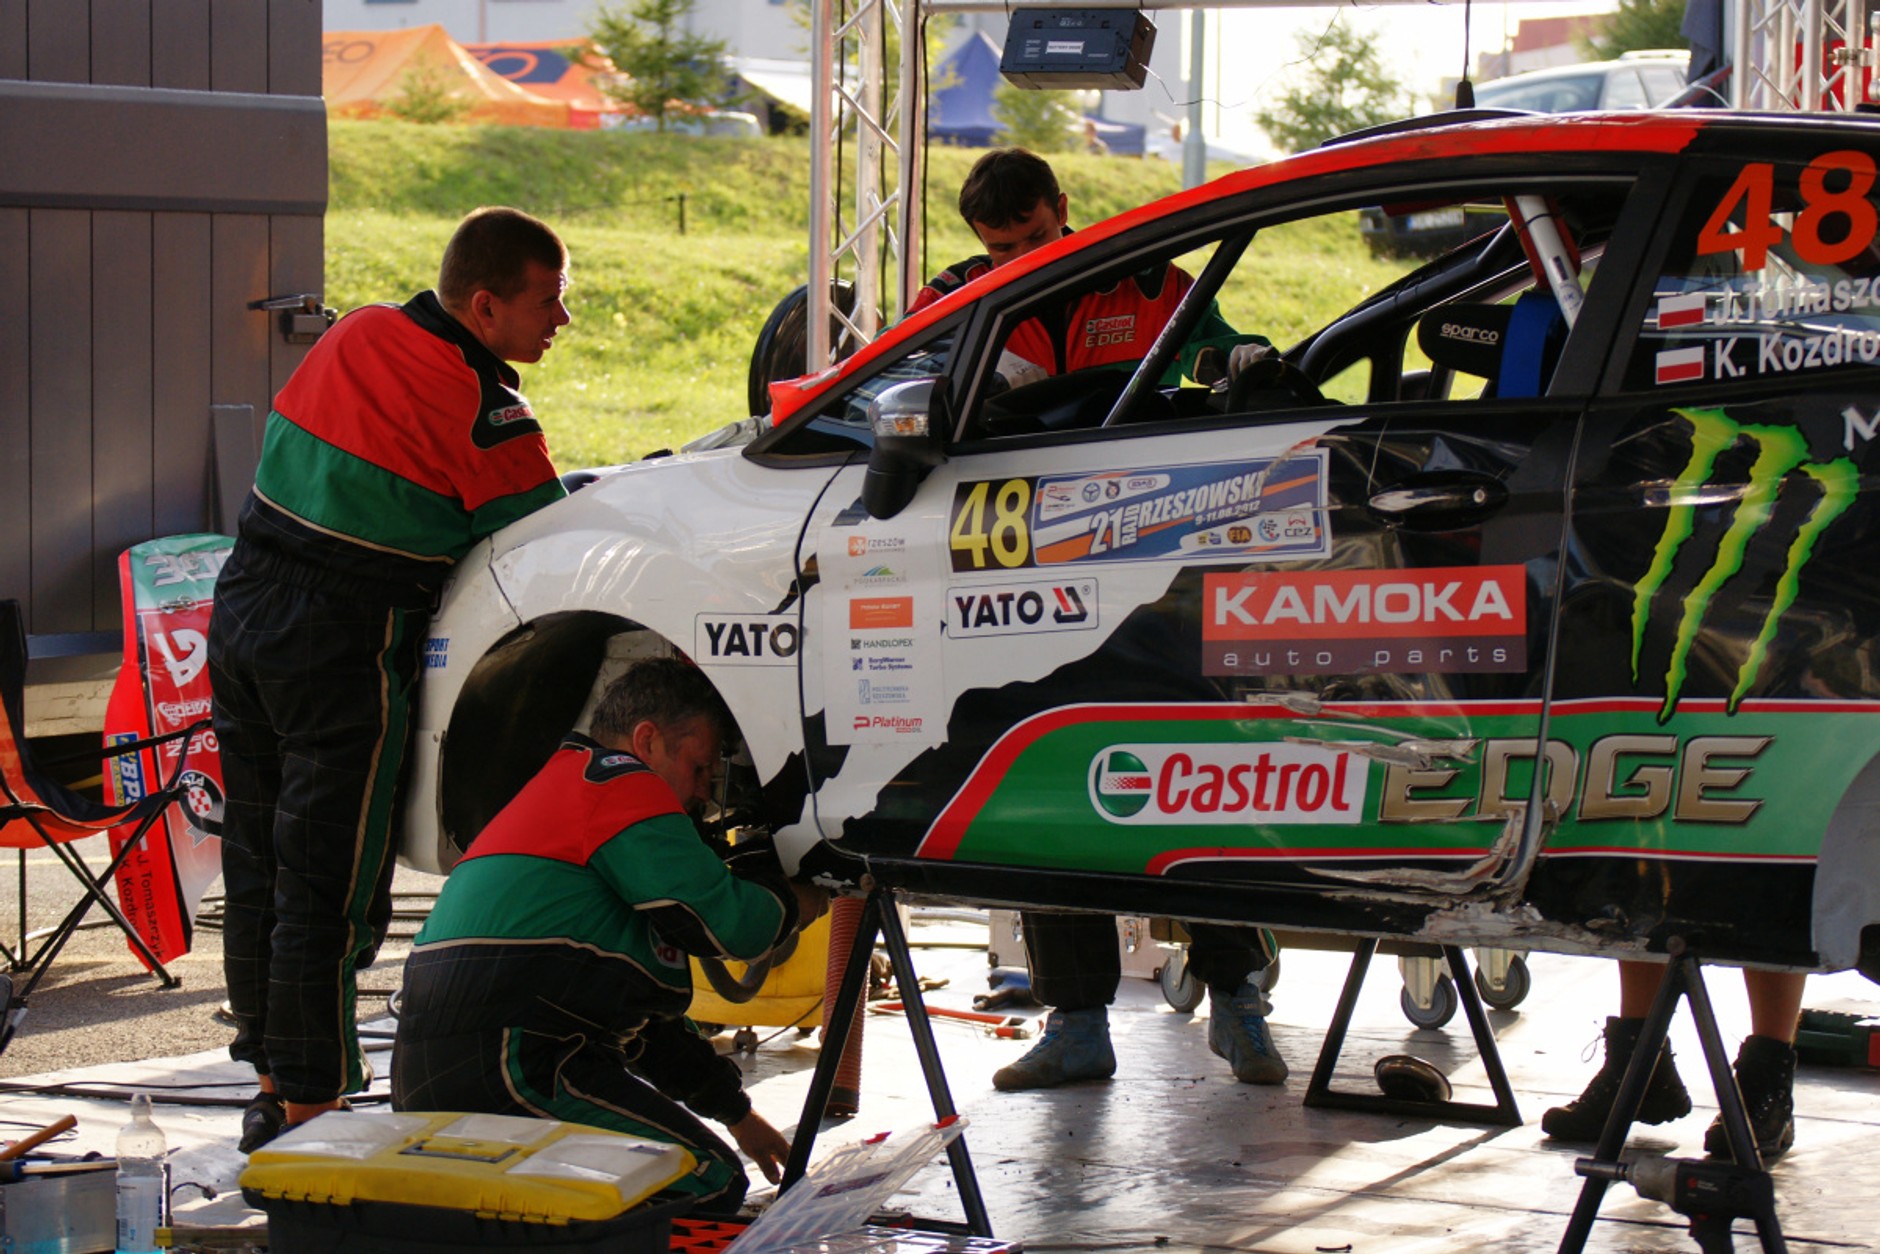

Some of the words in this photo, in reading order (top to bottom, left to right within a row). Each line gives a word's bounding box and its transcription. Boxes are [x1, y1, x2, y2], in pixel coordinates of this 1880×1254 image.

[1696, 150, 1879, 273] 48
[1085, 331, 1135, 348] EDGE
[1441, 322, 1500, 343] sparco
[1715, 337, 1747, 379] K.
[951, 478, 1032, 569] 48
[1122, 503, 1142, 546] RAJD
[1137, 470, 1267, 529] RZESZOWSKI
[1230, 529, 1252, 541] FIA
[955, 590, 1045, 629] YATO
[1214, 580, 1513, 626] KAMOKA
[704, 622, 798, 657] YATO
[863, 639, 914, 649] HANDLOPEX
[1223, 650, 1333, 667] auto
[1374, 646, 1508, 668] parts
[872, 716, 923, 727] Platinum
[1156, 749, 1352, 817] Castrol
[1377, 736, 1777, 825] EDGE
